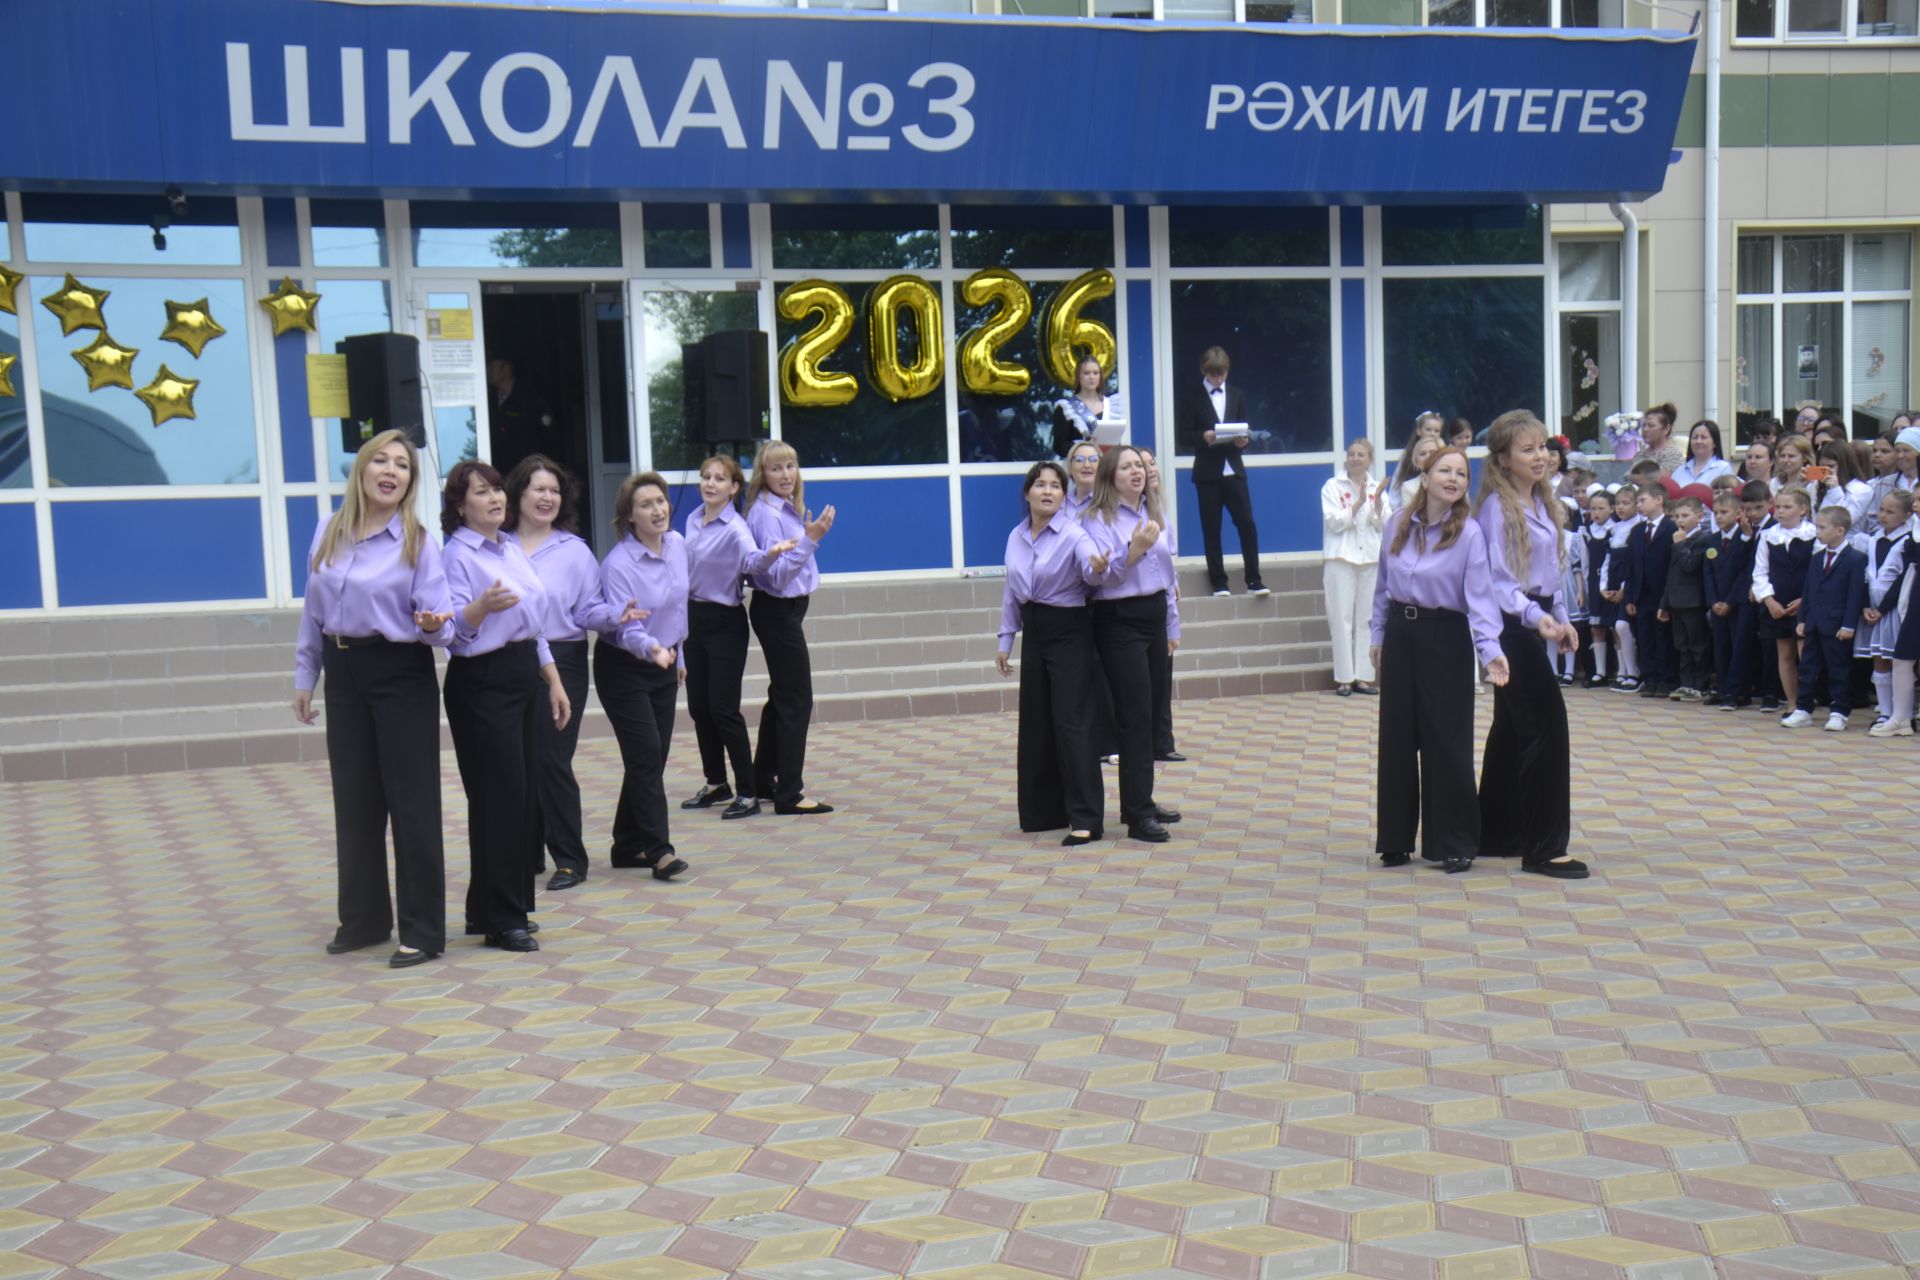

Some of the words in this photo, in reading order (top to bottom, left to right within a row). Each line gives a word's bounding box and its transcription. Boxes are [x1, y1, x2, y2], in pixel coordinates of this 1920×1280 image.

[226, 42, 747, 149] ШКОЛА
[1205, 81, 1428, 131] РӘХИМ
[1445, 88, 1647, 134] ИТЕГЕЗ
[778, 267, 1117, 408] 2026
